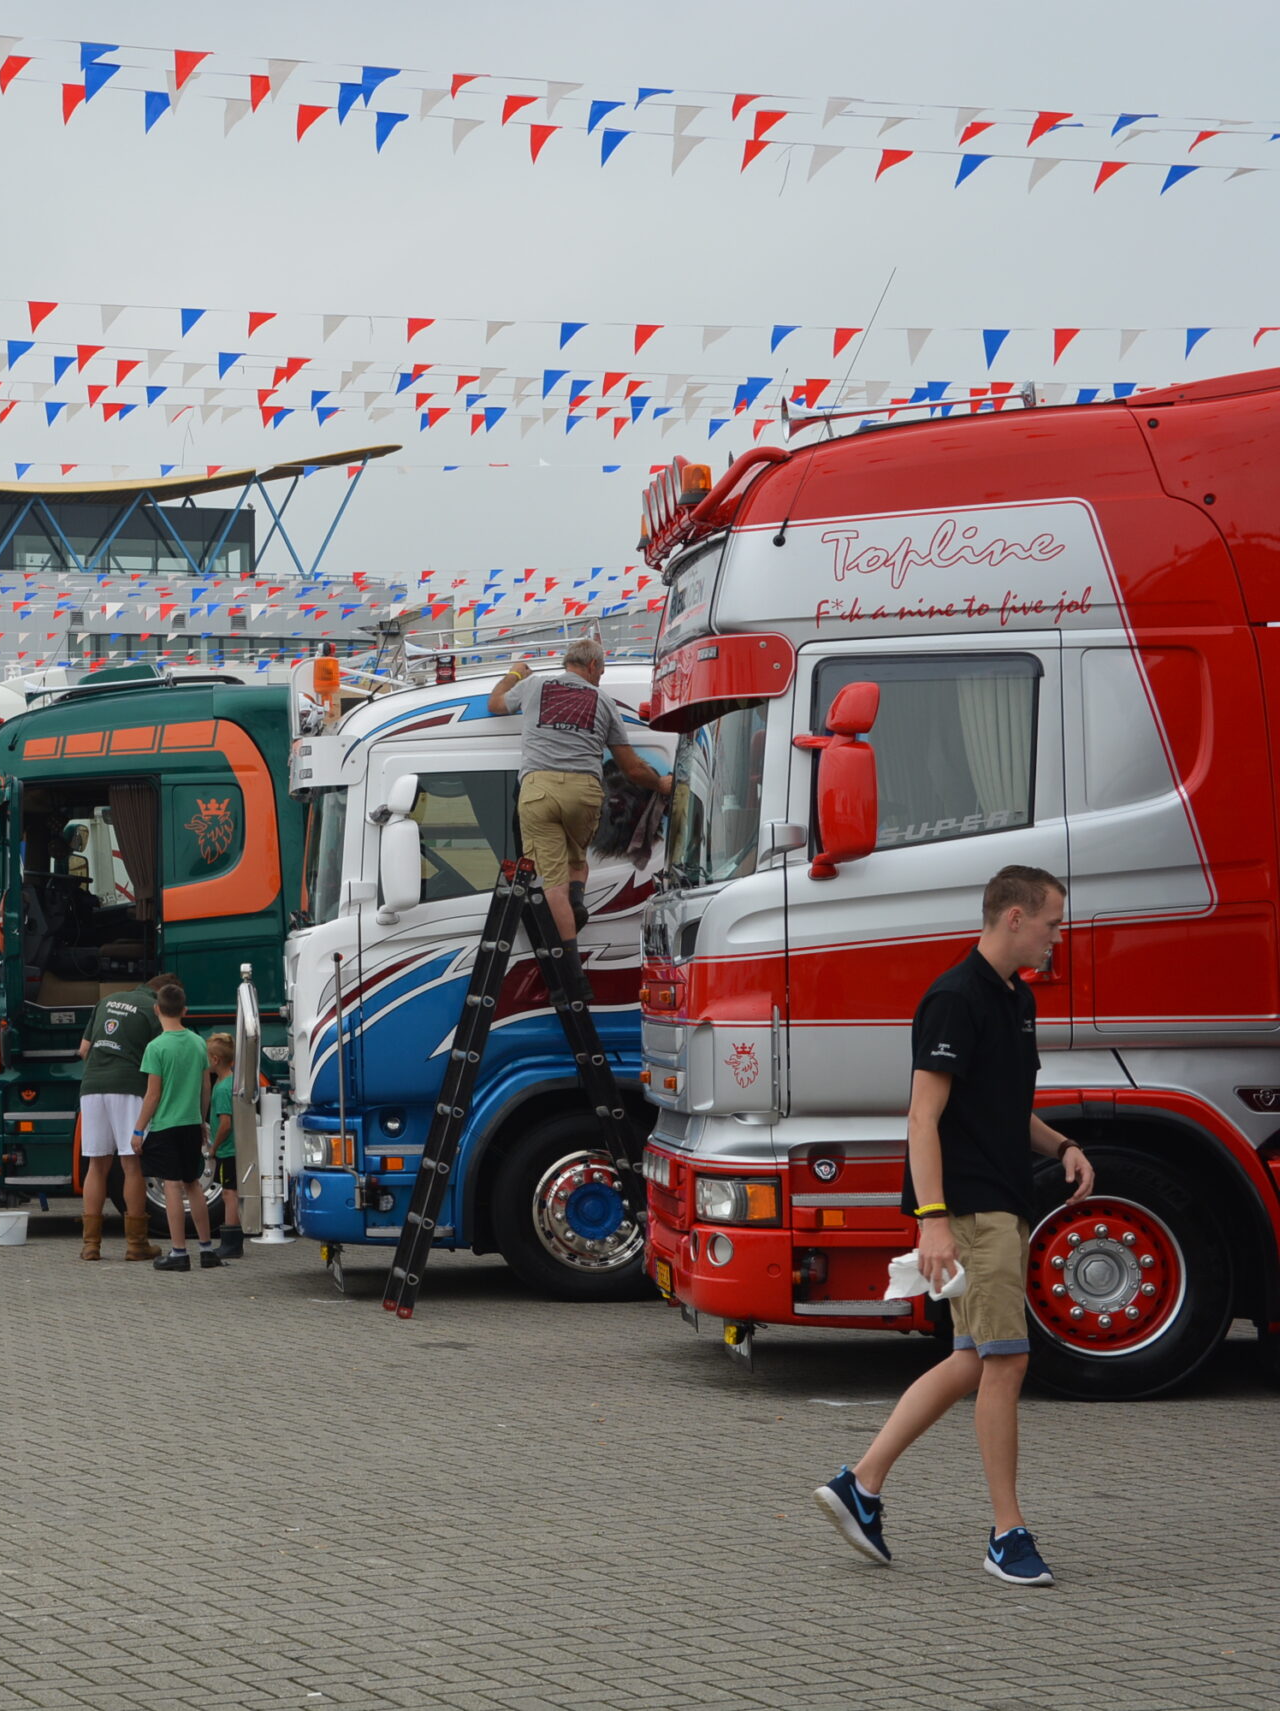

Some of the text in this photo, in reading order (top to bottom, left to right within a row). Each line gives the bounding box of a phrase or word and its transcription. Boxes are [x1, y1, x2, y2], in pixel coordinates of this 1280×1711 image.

[821, 519, 1066, 590] Topline
[872, 605, 894, 619] a
[896, 598, 958, 620] nine
[963, 595, 991, 618] to
[1000, 591, 1050, 626] five
[1054, 586, 1093, 624] job
[878, 810, 1010, 843] SUPER
[106, 1001, 137, 1014] POSTMA
